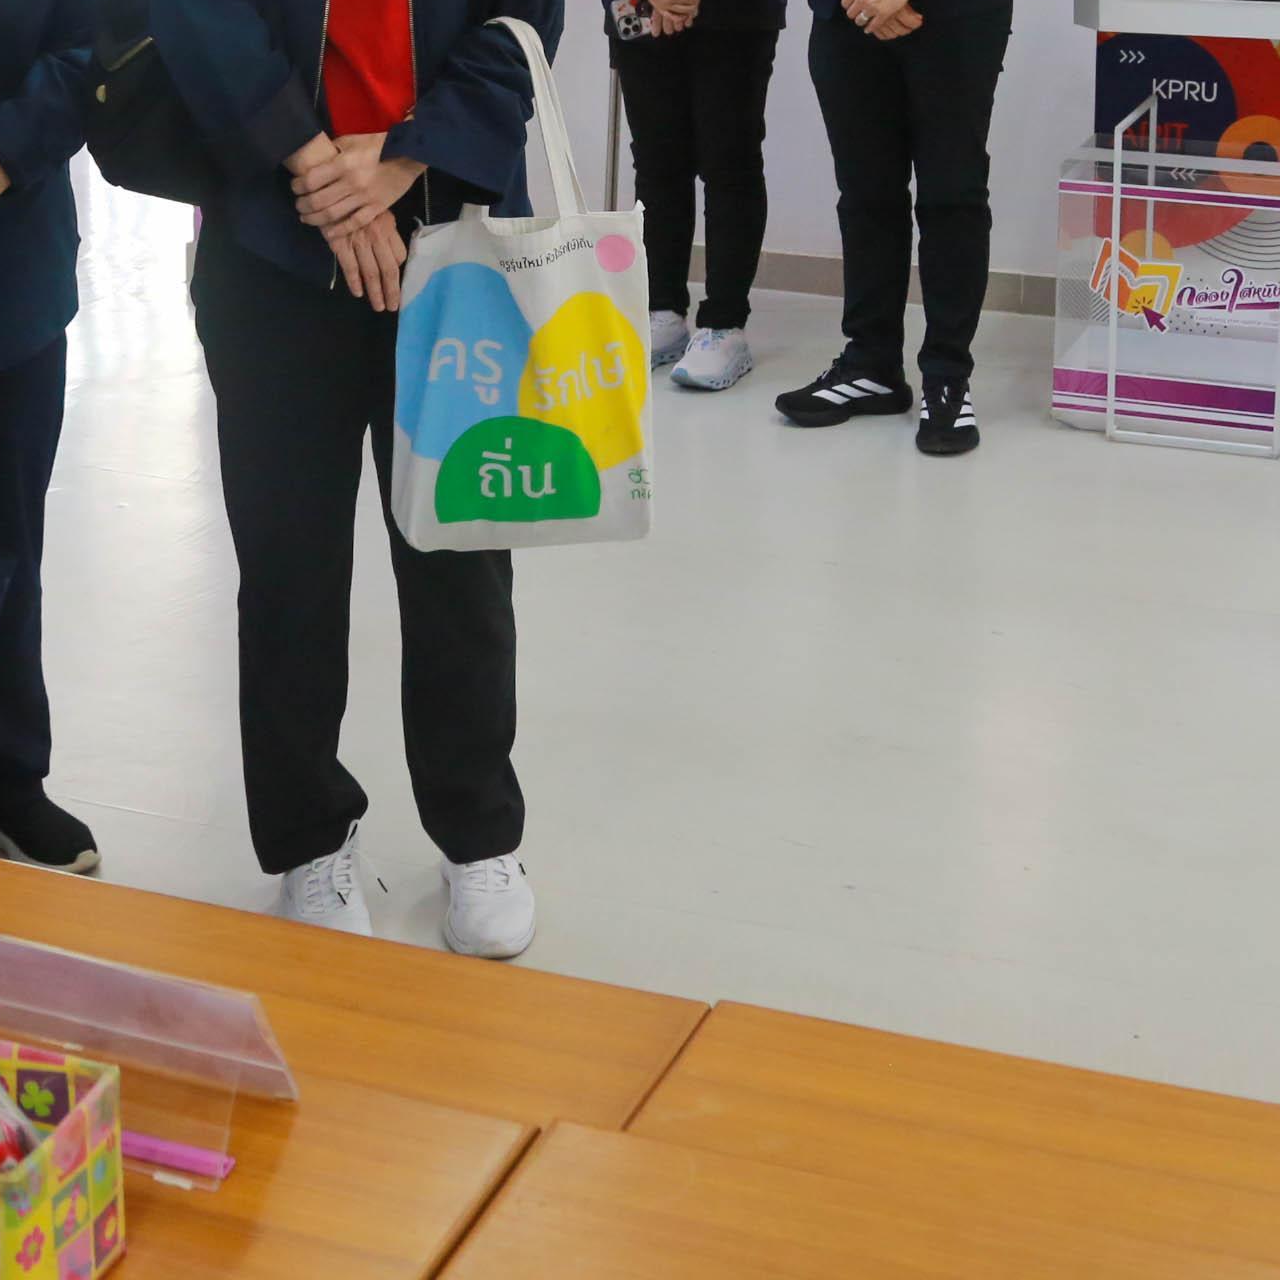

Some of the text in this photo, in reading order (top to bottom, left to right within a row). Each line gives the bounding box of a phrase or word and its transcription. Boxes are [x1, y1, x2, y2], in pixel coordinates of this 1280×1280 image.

[1152, 78, 1218, 103] KPRU
[428, 337, 504, 405] ครู
[478, 437, 557, 500] ถิ่น
